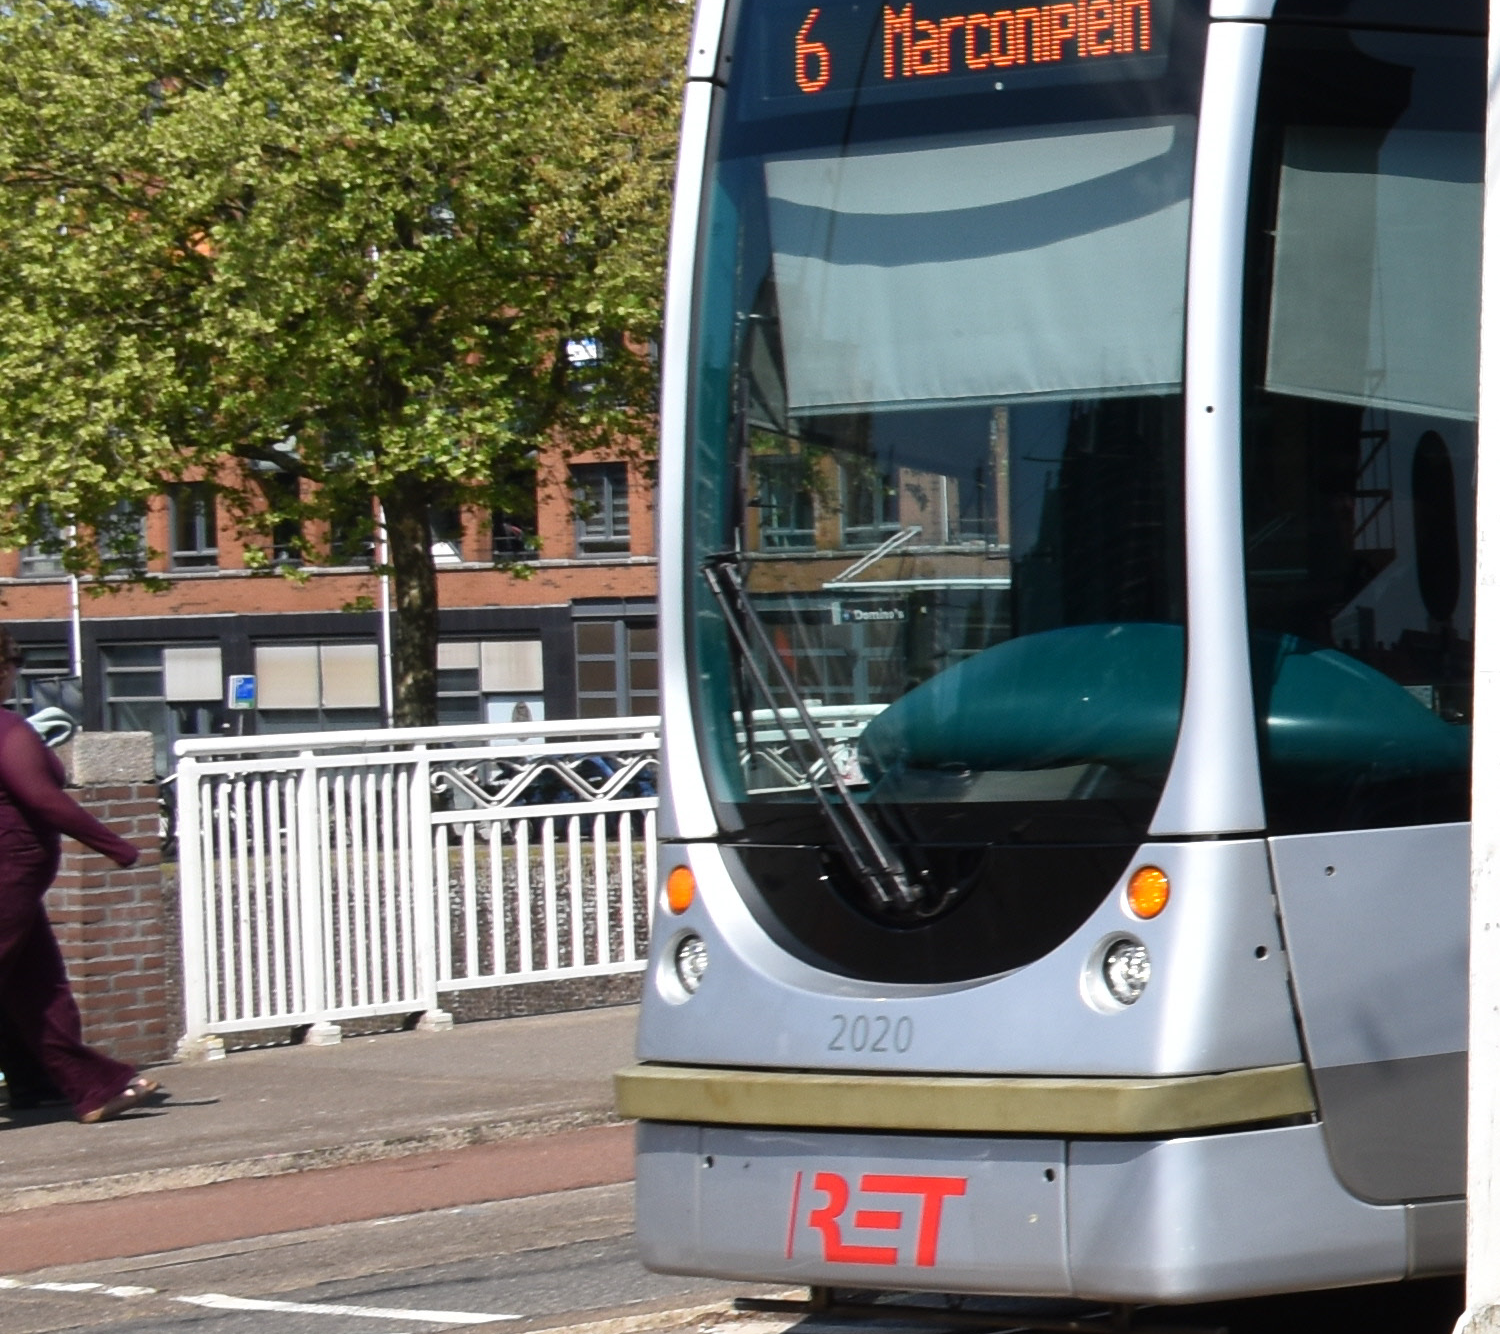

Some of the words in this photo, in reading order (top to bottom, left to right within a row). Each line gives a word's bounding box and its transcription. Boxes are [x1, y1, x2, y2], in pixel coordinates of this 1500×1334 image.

[795, 7, 830, 93] 6
[853, 608, 905, 621] Domino's
[828, 1013, 914, 1054] 2020
[784, 1170, 968, 1268] RET
